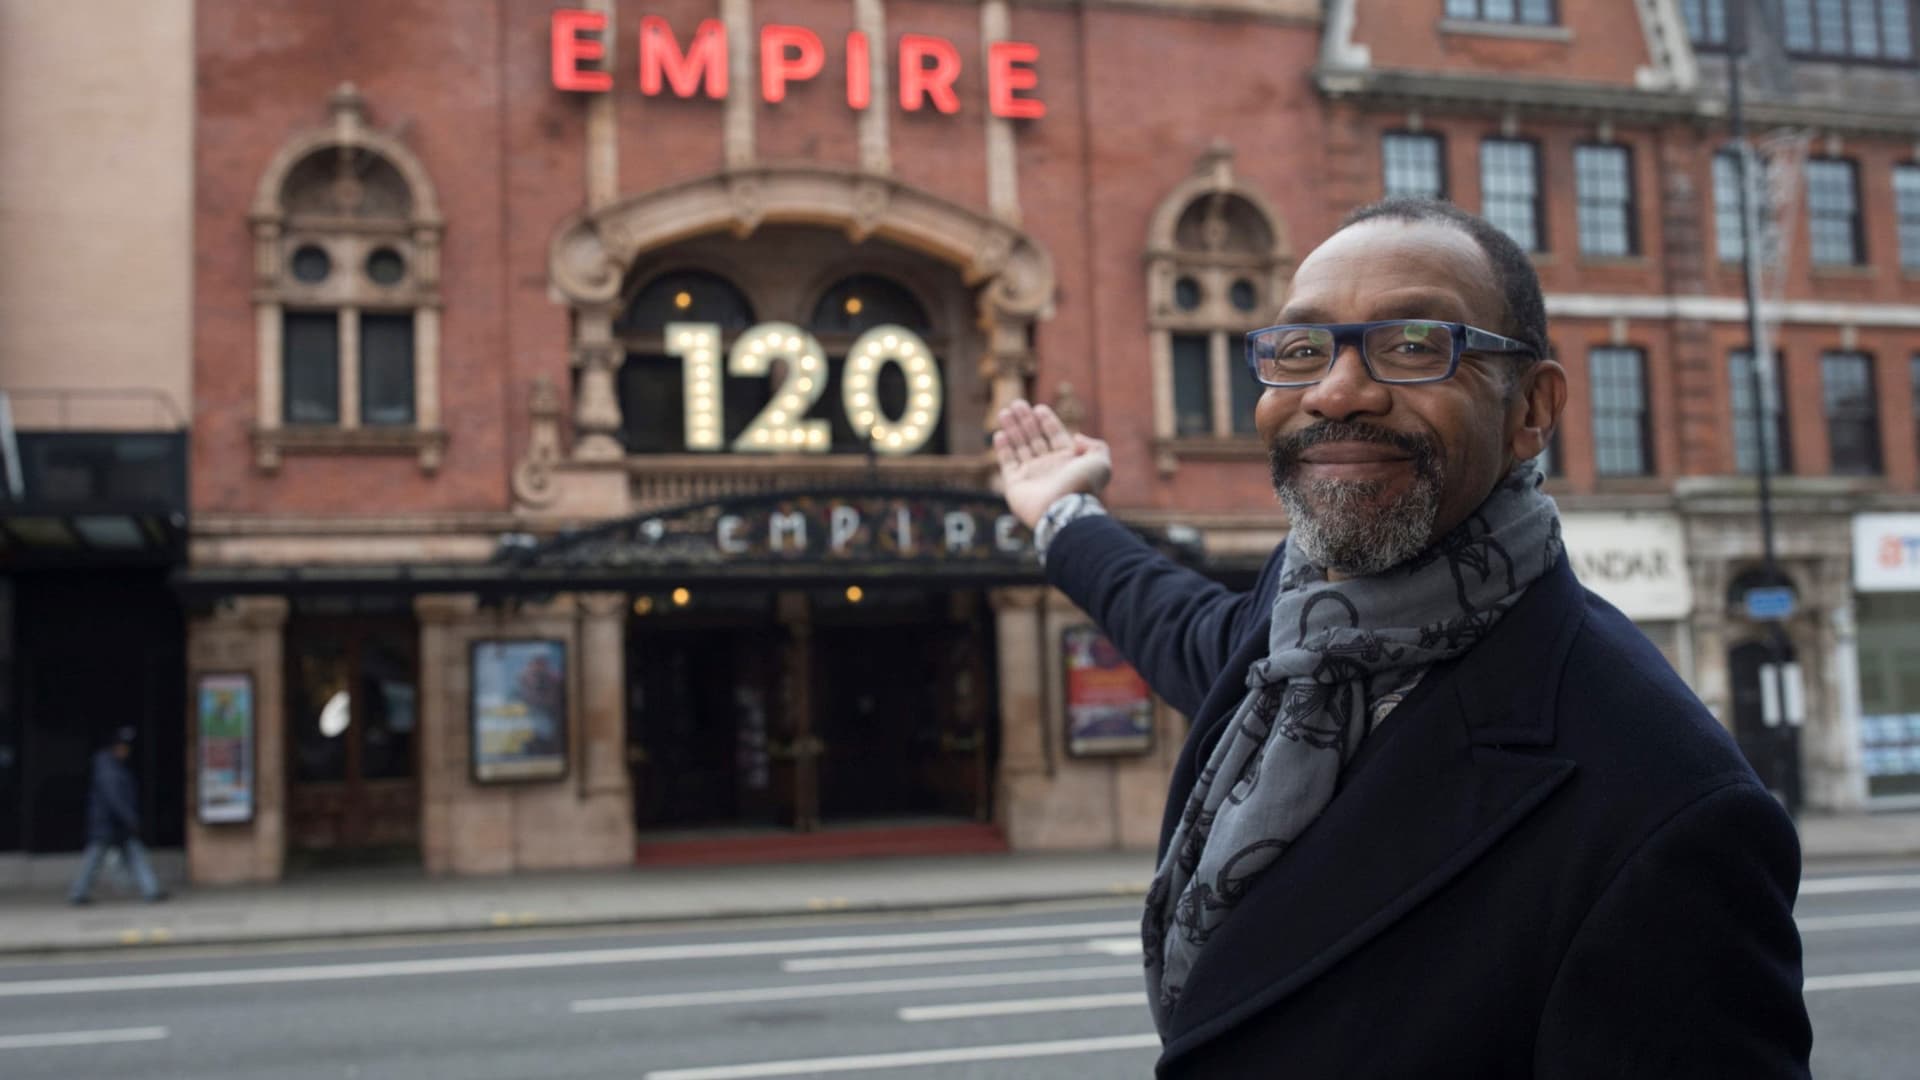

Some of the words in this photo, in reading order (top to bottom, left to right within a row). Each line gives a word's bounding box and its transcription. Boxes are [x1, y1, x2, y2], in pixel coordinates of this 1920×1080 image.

[551, 9, 1047, 119] EMPIRE
[665, 321, 943, 455] 120
[717, 505, 1024, 553] EMPIRE
